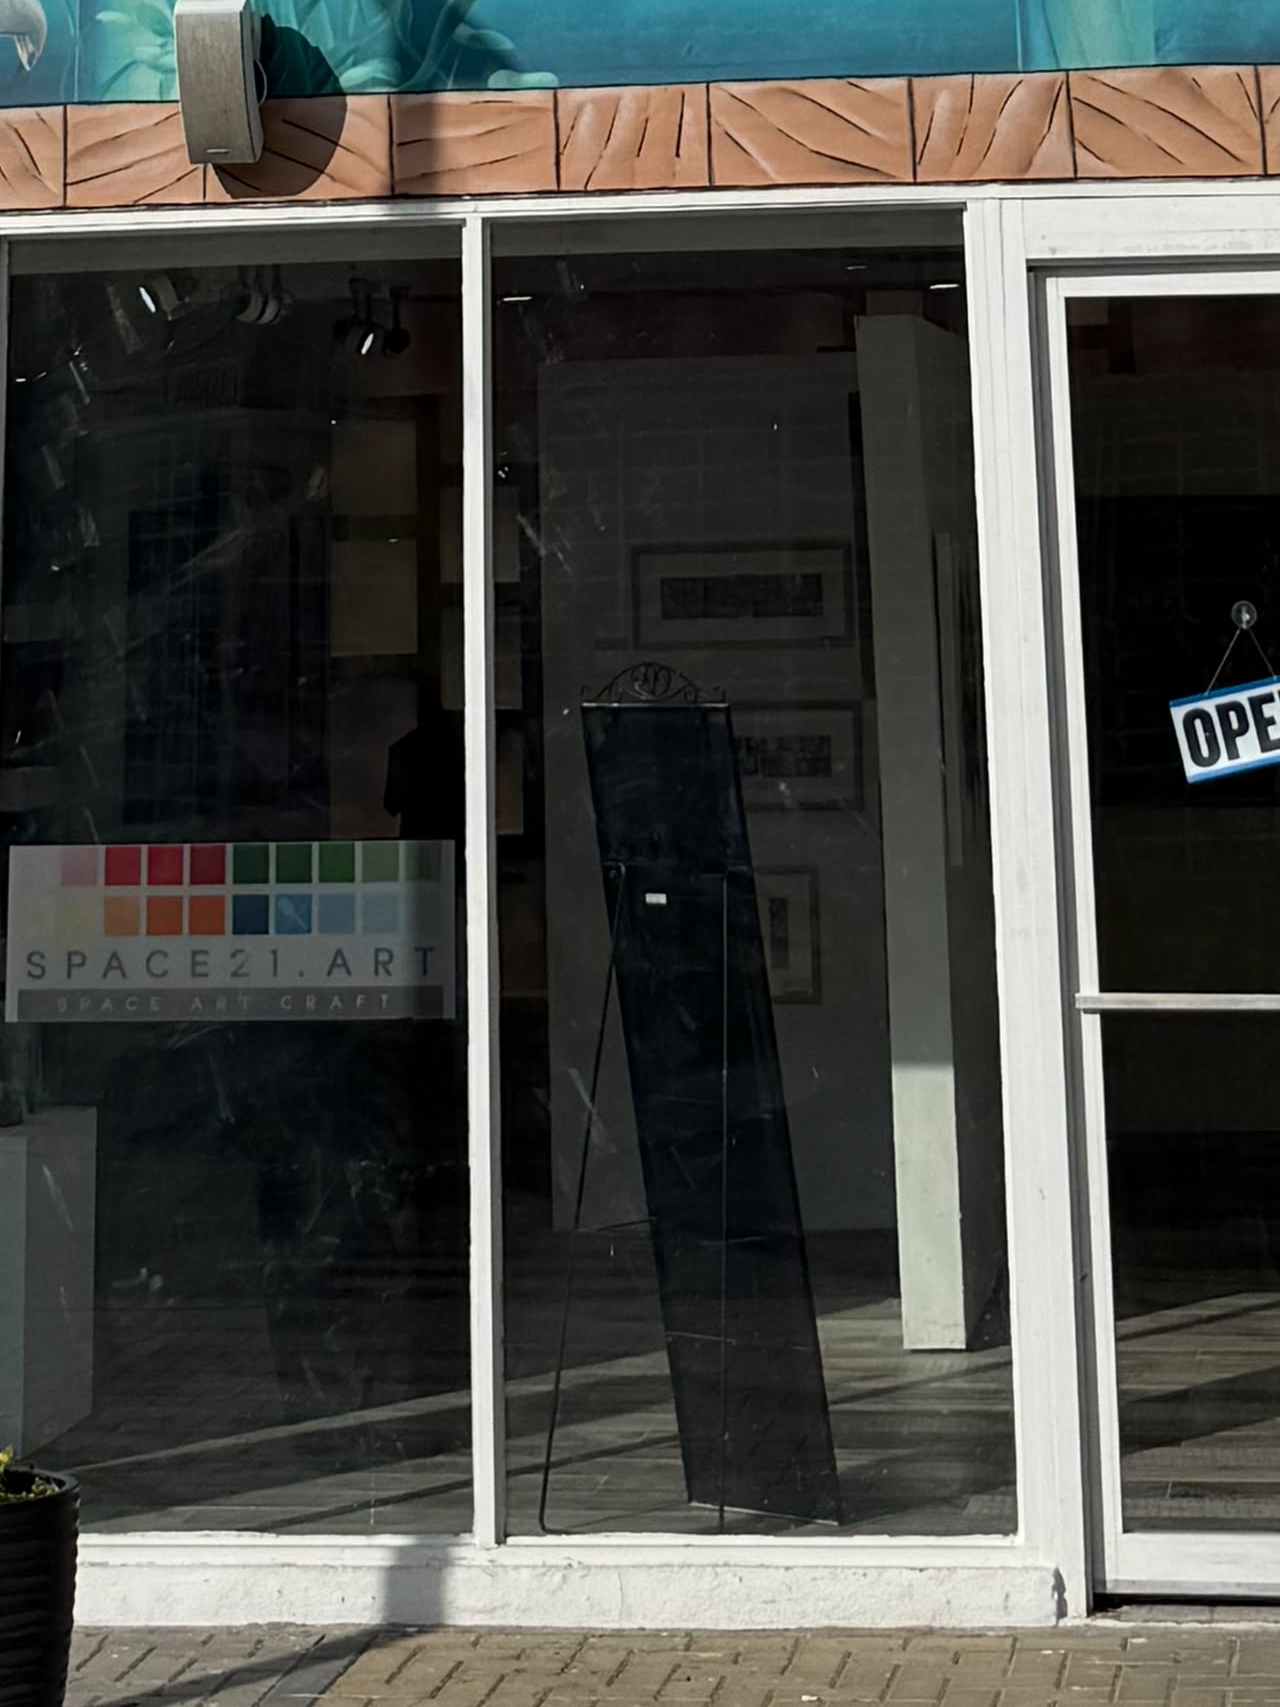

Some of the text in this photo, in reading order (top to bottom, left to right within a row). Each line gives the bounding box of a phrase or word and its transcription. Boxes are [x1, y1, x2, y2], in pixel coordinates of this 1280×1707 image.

[56, 994, 391, 1013] SPACE ART CRAFT
